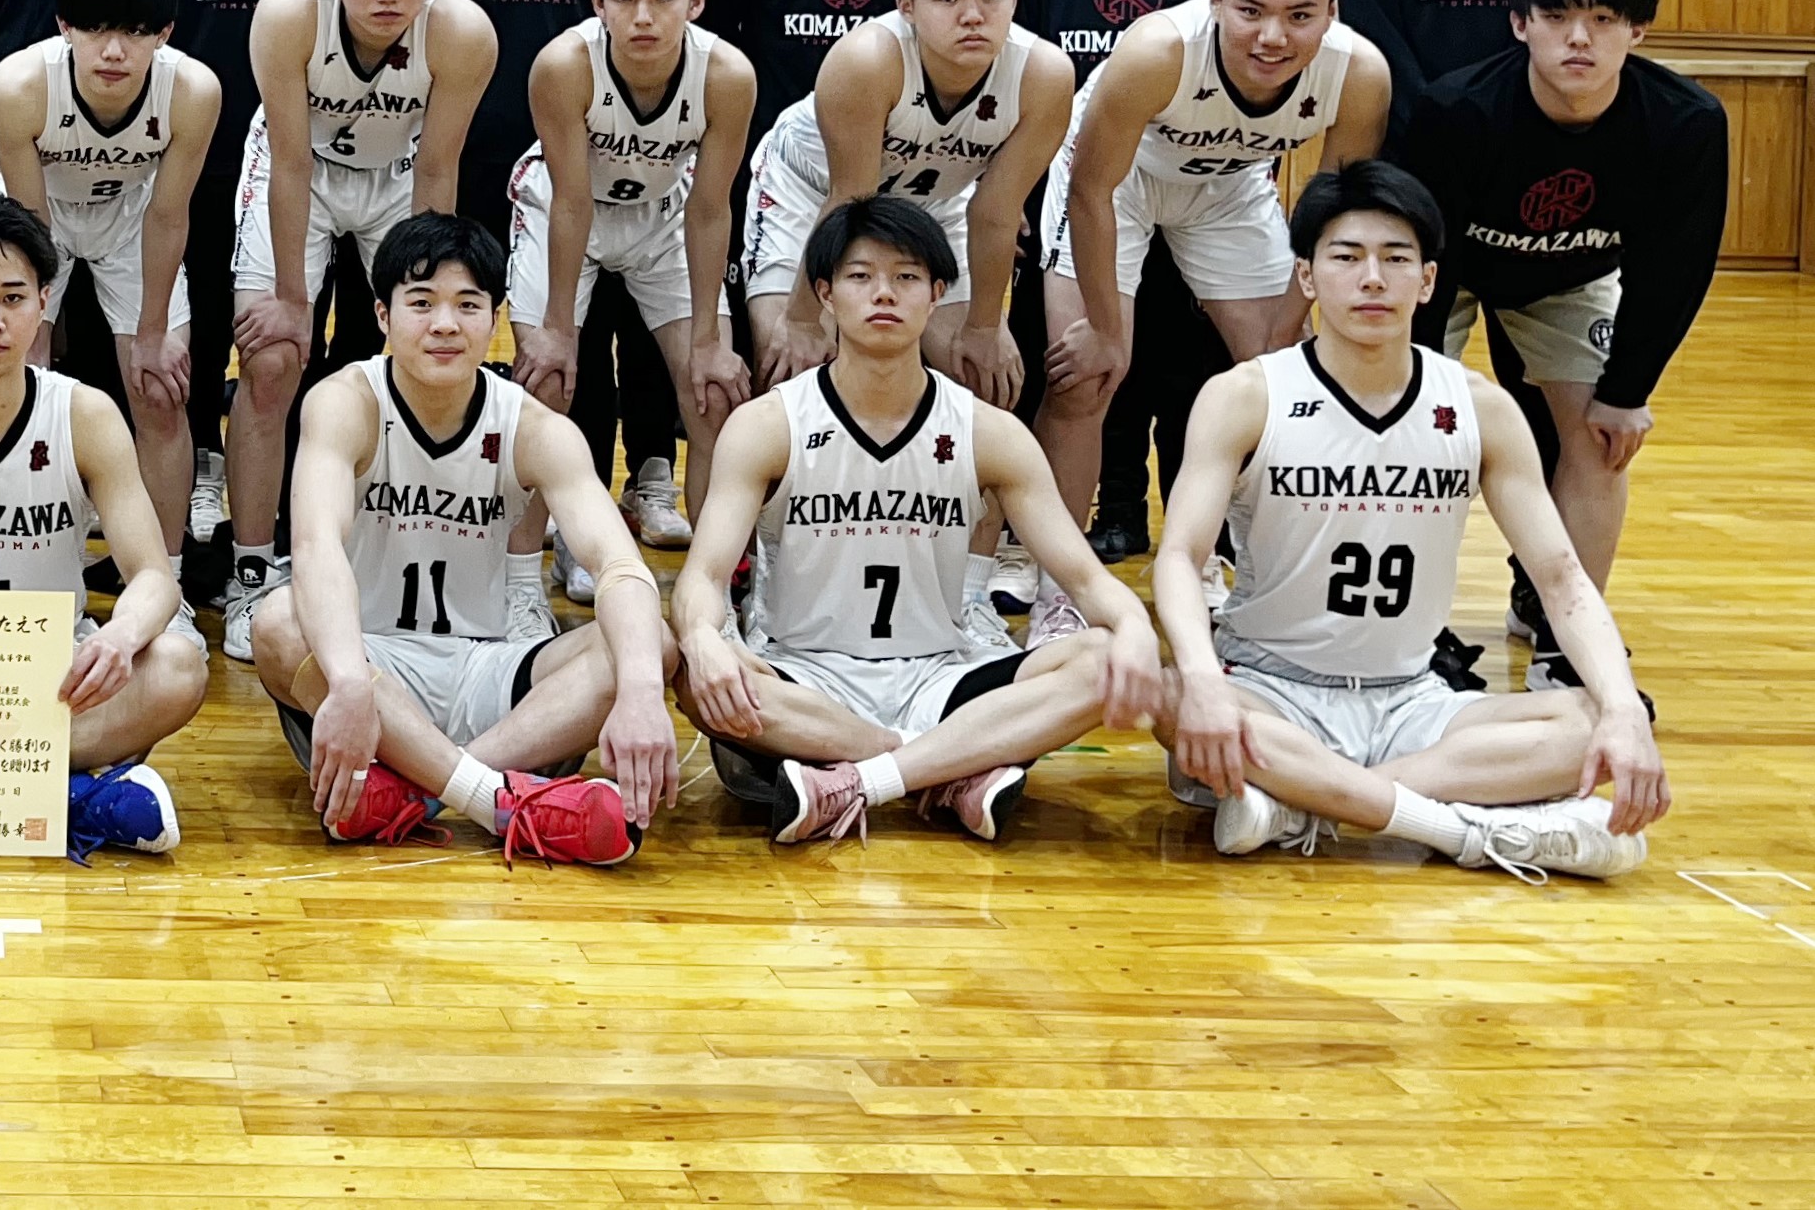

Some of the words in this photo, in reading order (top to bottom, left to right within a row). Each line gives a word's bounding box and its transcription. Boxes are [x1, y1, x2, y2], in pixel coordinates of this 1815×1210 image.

[607, 177, 646, 201] 8
[1464, 222, 1622, 252] KOMAZAWA
[1288, 399, 1324, 419] BF
[805, 430, 836, 450] BF
[1267, 464, 1471, 500] KOMAZAWA
[785, 489, 967, 527] KOMAZAWA
[1300, 502, 1452, 515] TOMAKOMAI
[1326, 541, 1416, 619] 29
[395, 559, 451, 635] 11
[864, 564, 901, 639] 7
